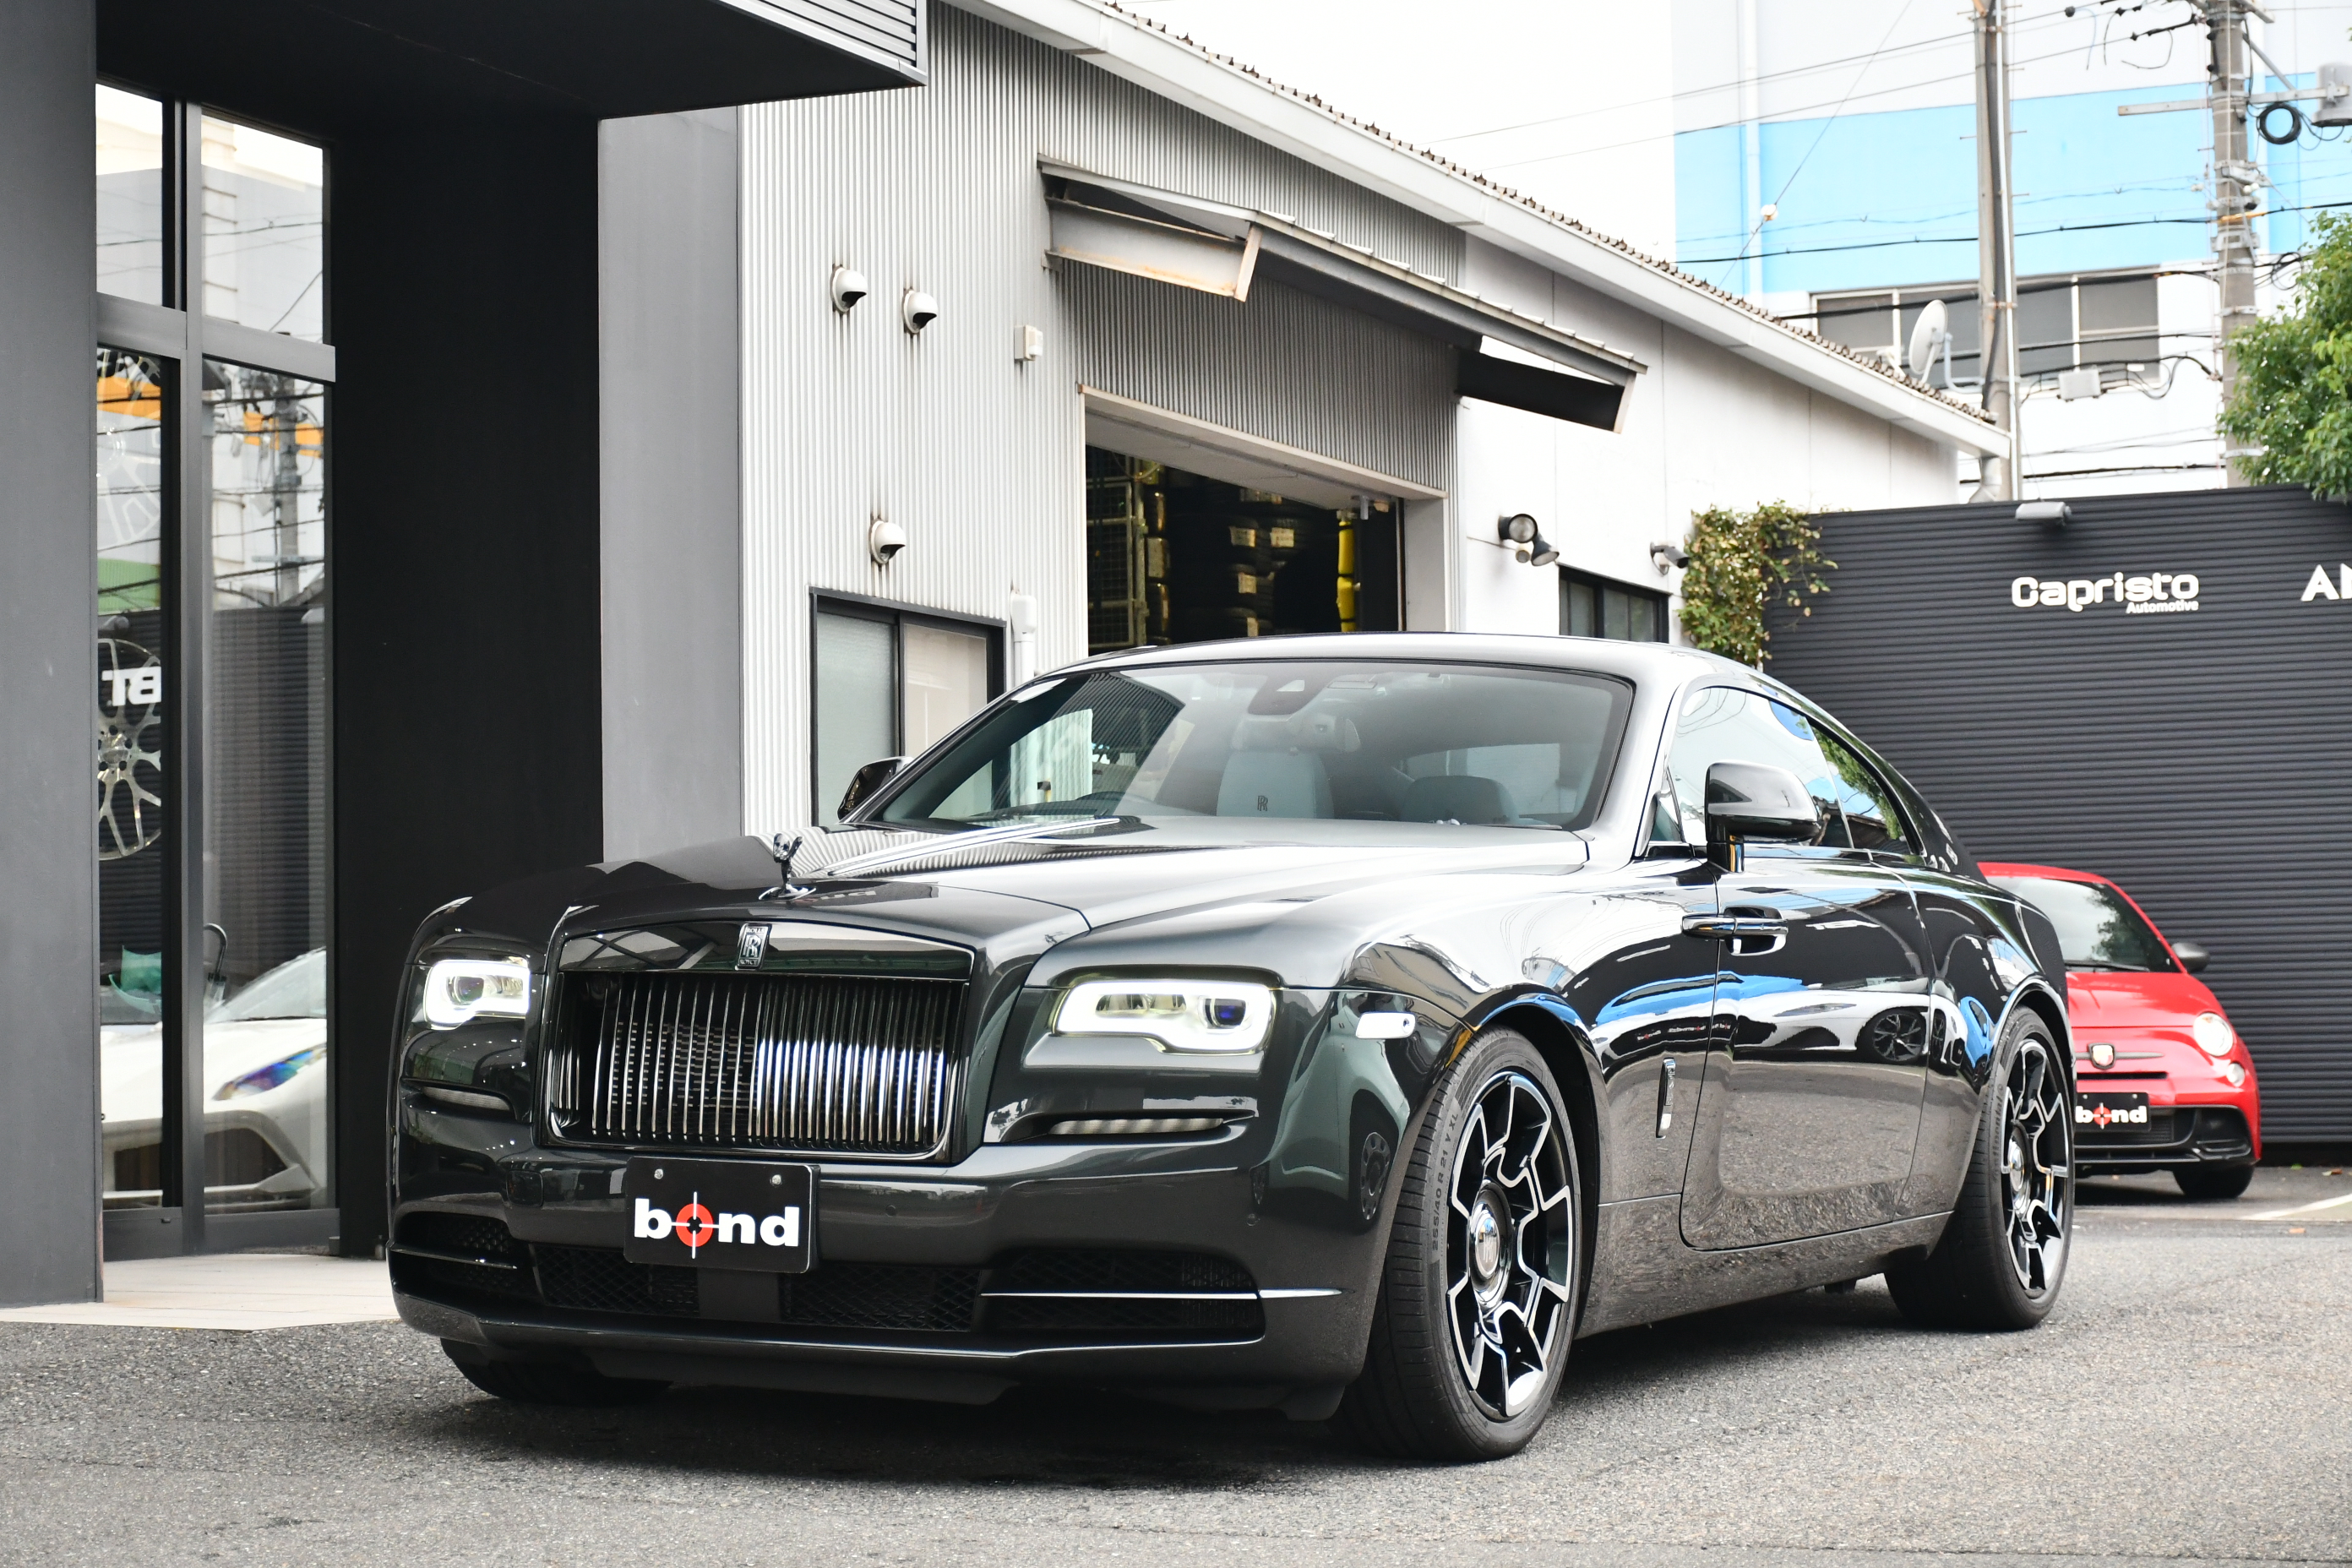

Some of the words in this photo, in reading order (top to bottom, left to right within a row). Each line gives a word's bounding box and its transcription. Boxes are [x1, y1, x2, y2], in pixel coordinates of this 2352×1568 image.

[2012, 572, 2199, 612] Capristo
[2126, 599, 2199, 614] Automotive
[1448, 1113, 1459, 1131] XL
[2075, 1102, 2148, 1130] bond
[1440, 1149, 1448, 1168] 21
[1437, 1172, 1444, 1184] R
[634, 1191, 800, 1259] bond
